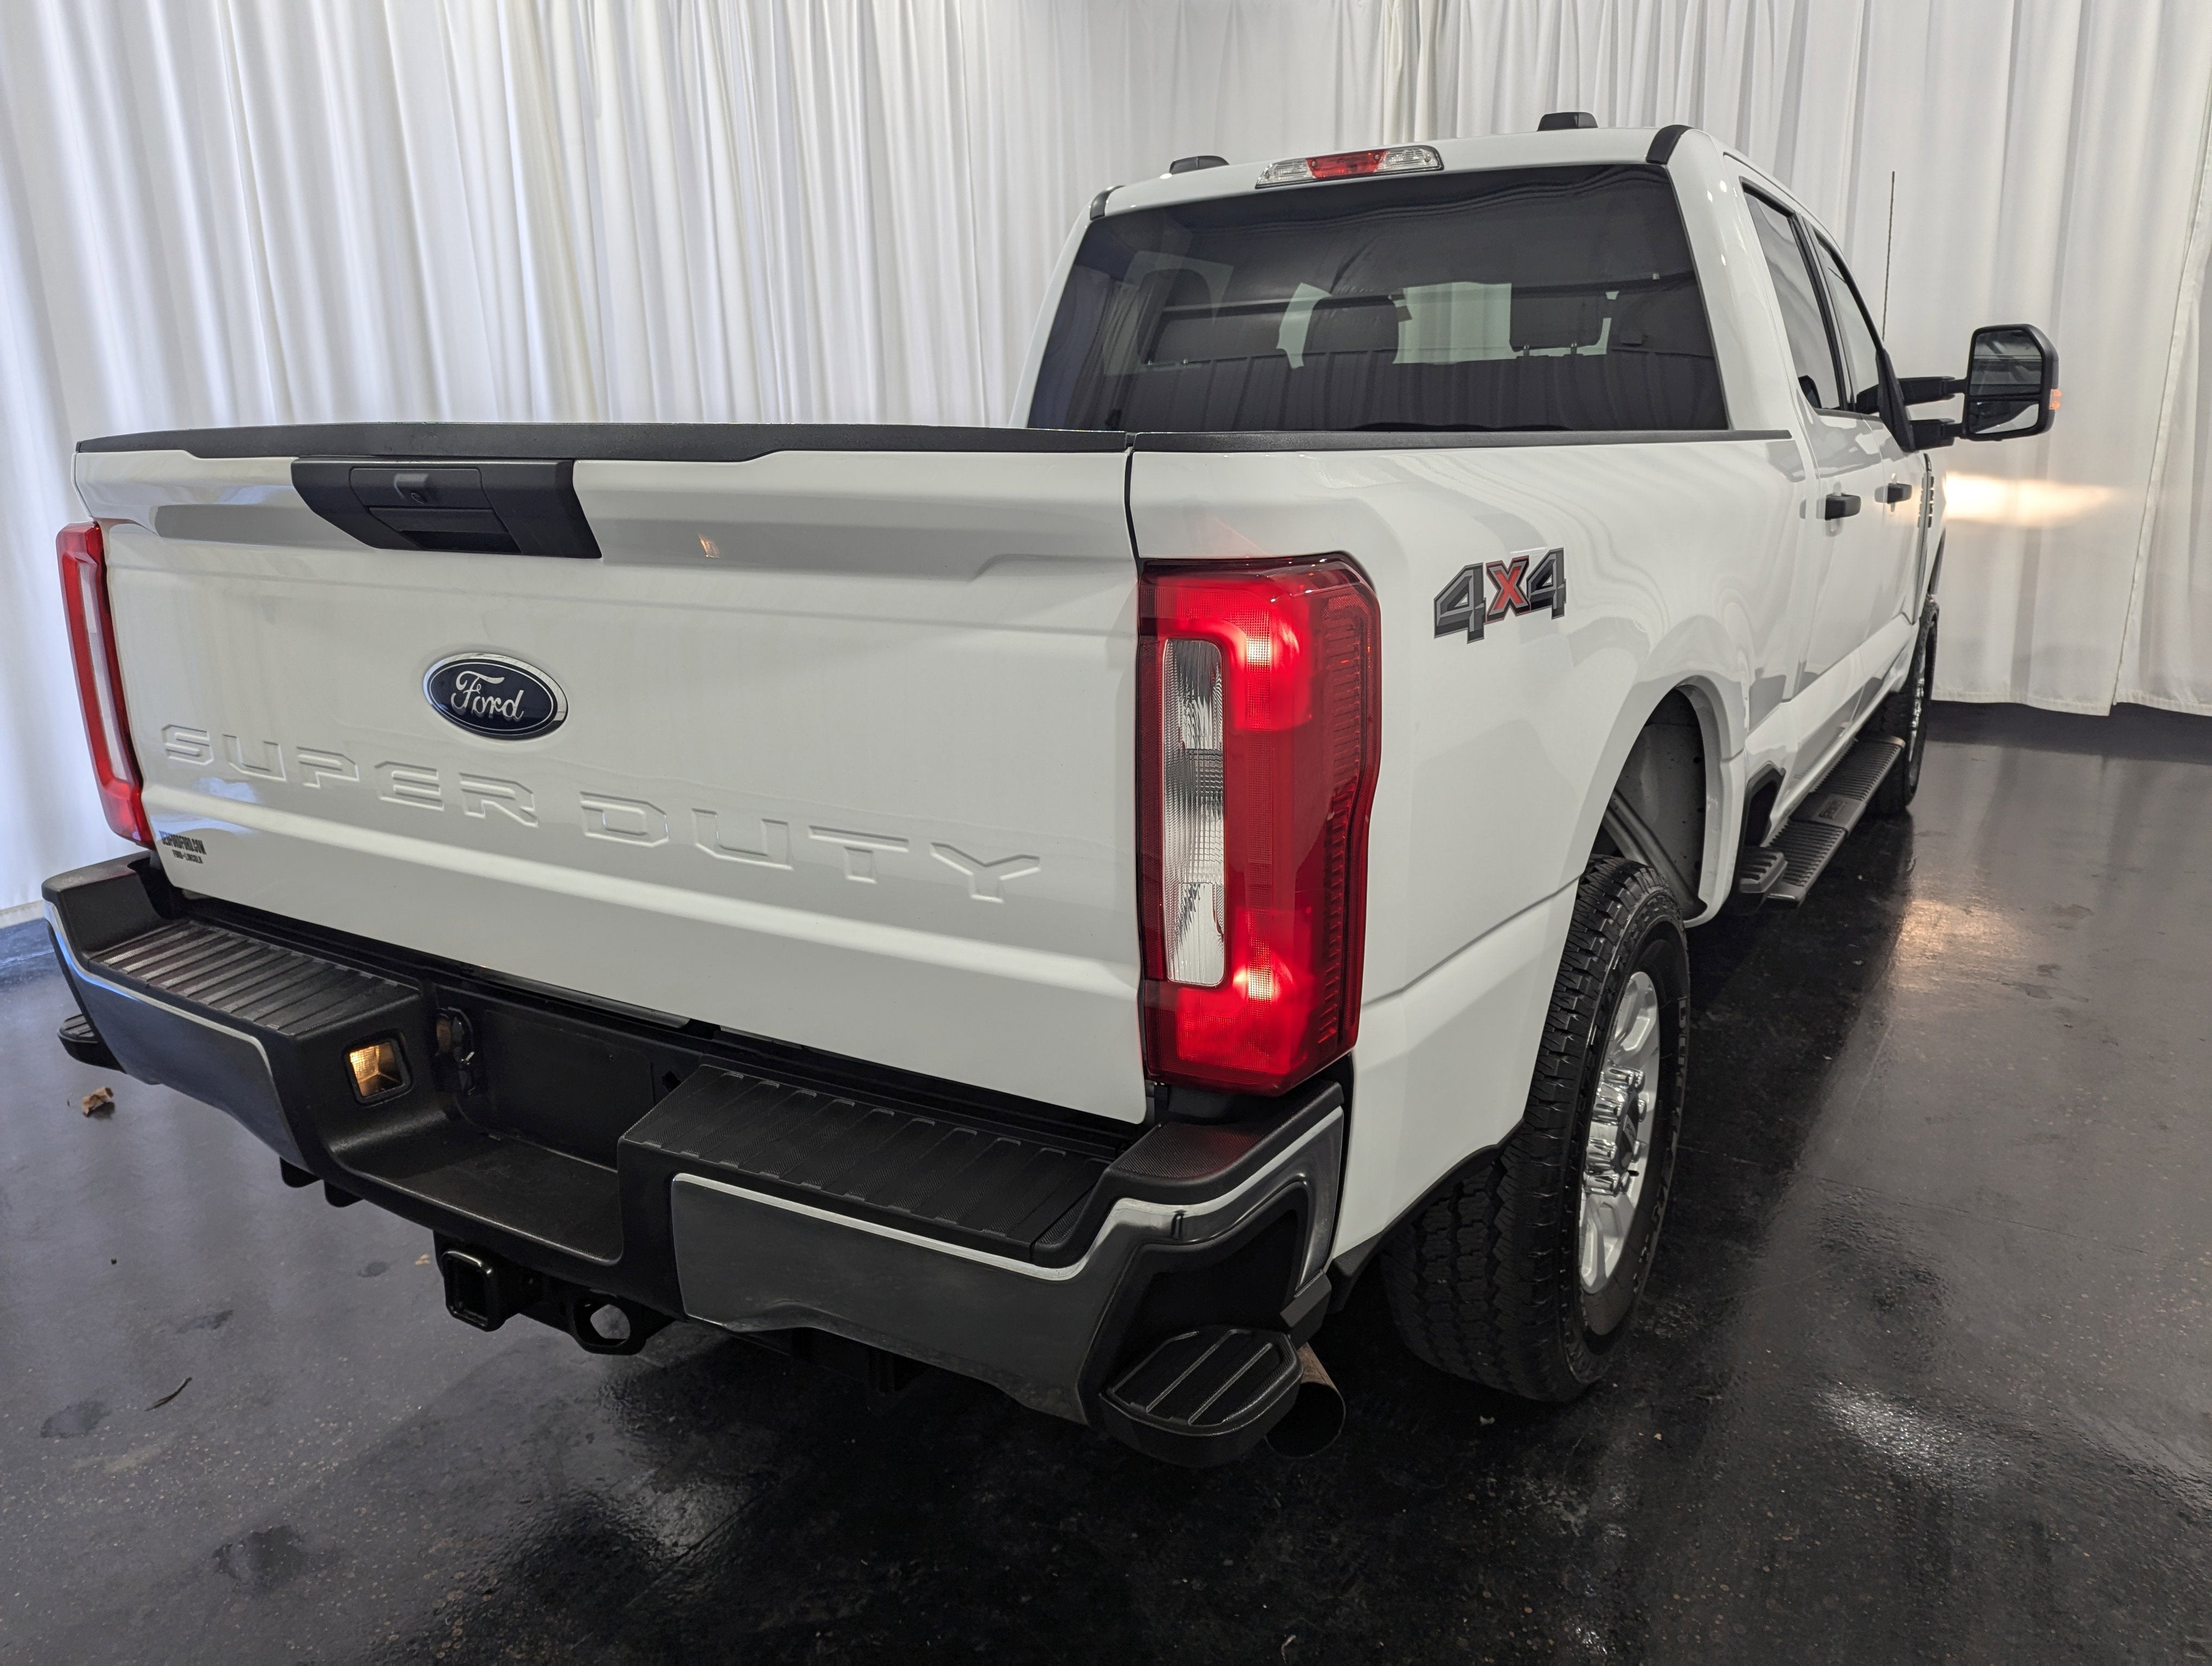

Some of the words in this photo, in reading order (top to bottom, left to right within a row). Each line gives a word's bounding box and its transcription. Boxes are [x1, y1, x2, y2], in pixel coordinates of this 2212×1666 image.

[1433, 547, 1566, 644] 4X4
[451, 670, 525, 721] Ford
[161, 723, 538, 828] SUPER
[580, 791, 1040, 903] DUTY
